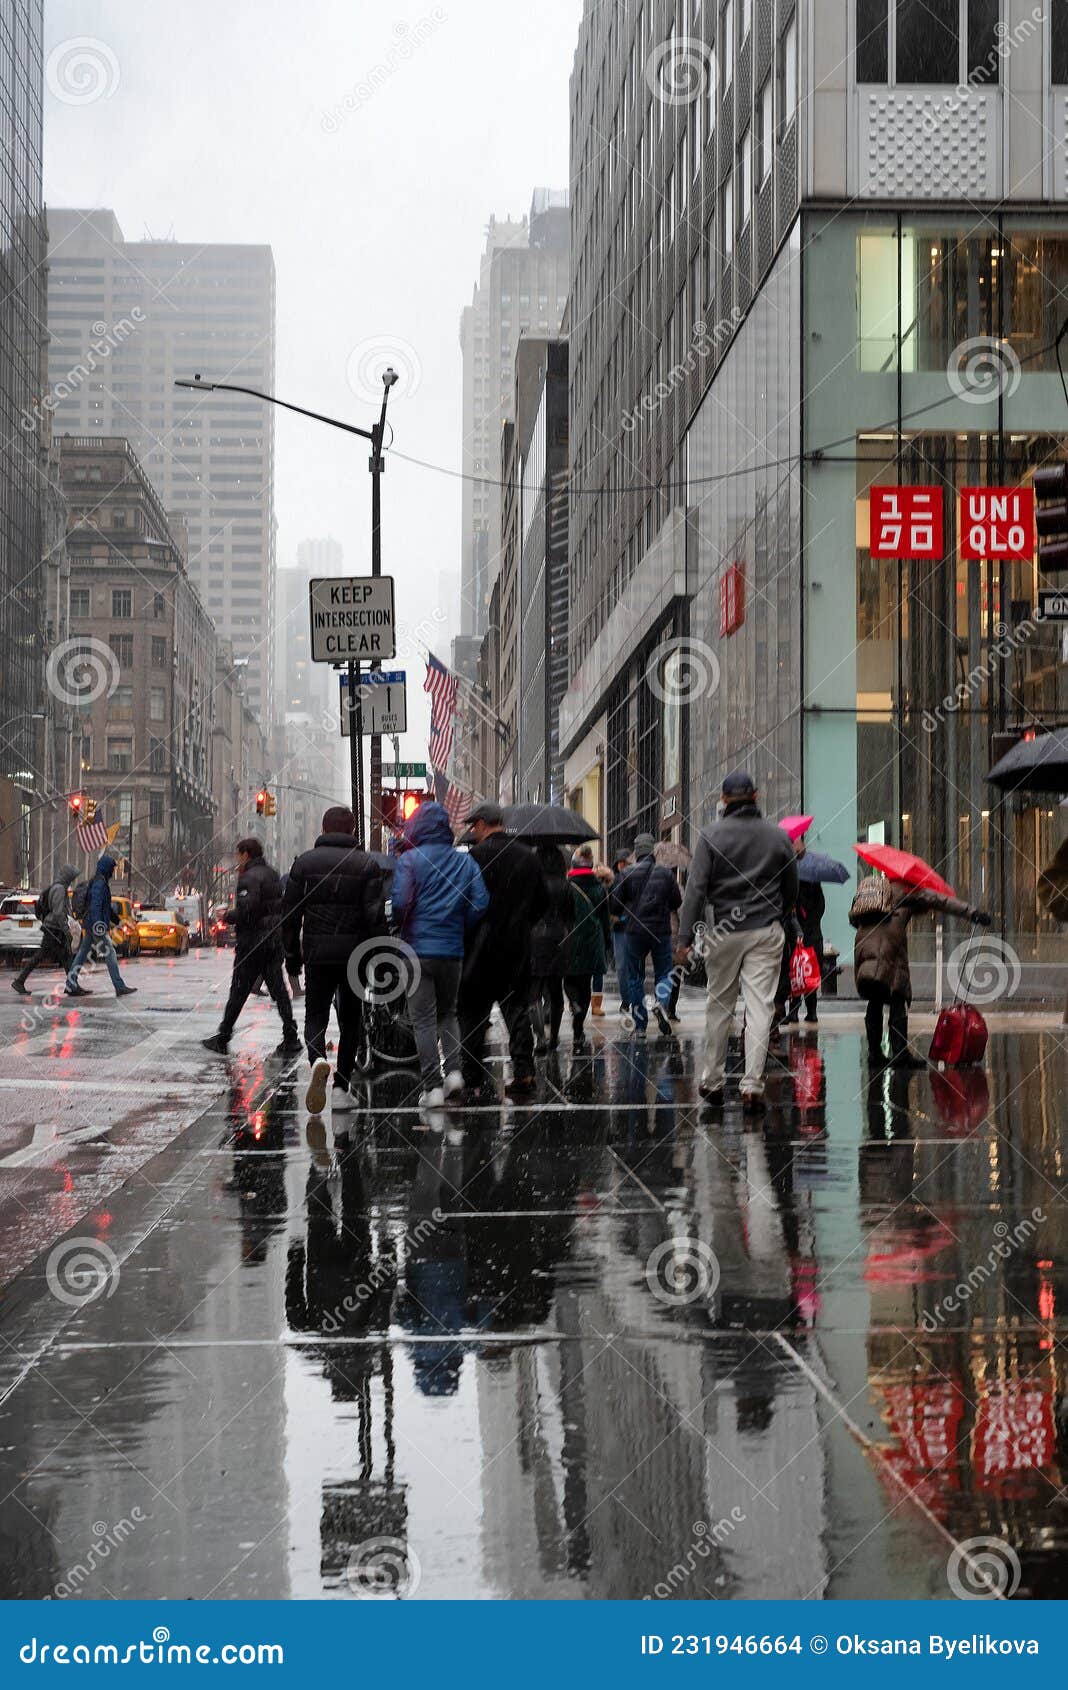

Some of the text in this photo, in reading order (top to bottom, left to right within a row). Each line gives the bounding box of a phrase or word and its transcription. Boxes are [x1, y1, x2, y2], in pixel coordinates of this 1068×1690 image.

[880, 494, 933, 520] ユニ
[969, 495, 1020, 522] UNI
[878, 524, 933, 550] クロ
[969, 524, 1025, 556] QLO
[331, 586, 373, 604] KEEP
[315, 609, 391, 629] INTERSECTION
[326, 634, 381, 653] CLEAR
[382, 722, 397, 731] ONLY
